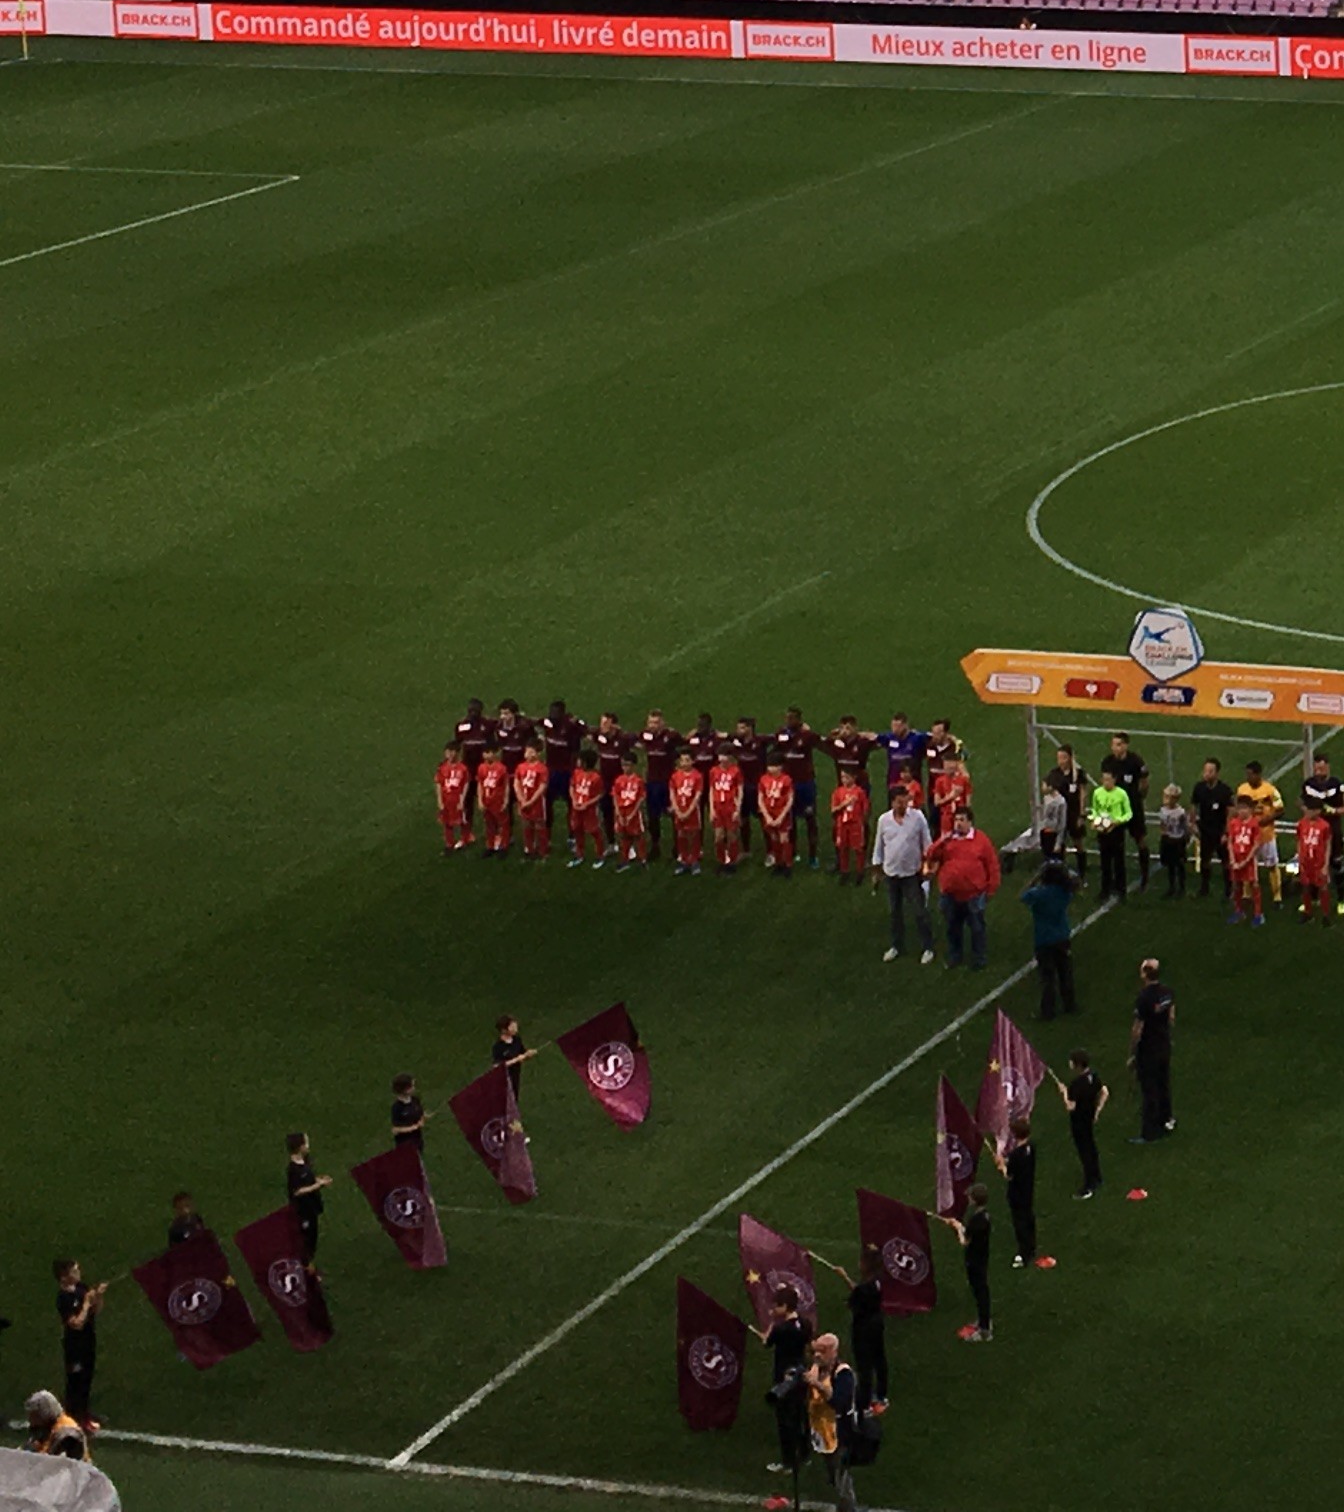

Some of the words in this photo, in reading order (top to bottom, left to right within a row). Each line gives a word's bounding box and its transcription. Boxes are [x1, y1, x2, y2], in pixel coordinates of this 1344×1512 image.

[121, 13, 191, 27] BRACK.CH
[215, 9, 369, 39] Commandé
[379, 15, 545, 49] aujourd'hui,
[553, 20, 614, 47] livré
[622, 21, 728, 51] demain
[752, 33, 826, 49] BRACK.CH
[871, 33, 945, 56] Mieux
[952, 36, 1044, 60] acheter
[1051, 44, 1080, 61] en
[1088, 40, 1147, 68] ligne
[1193, 48, 1272, 63] BRACK.CH
